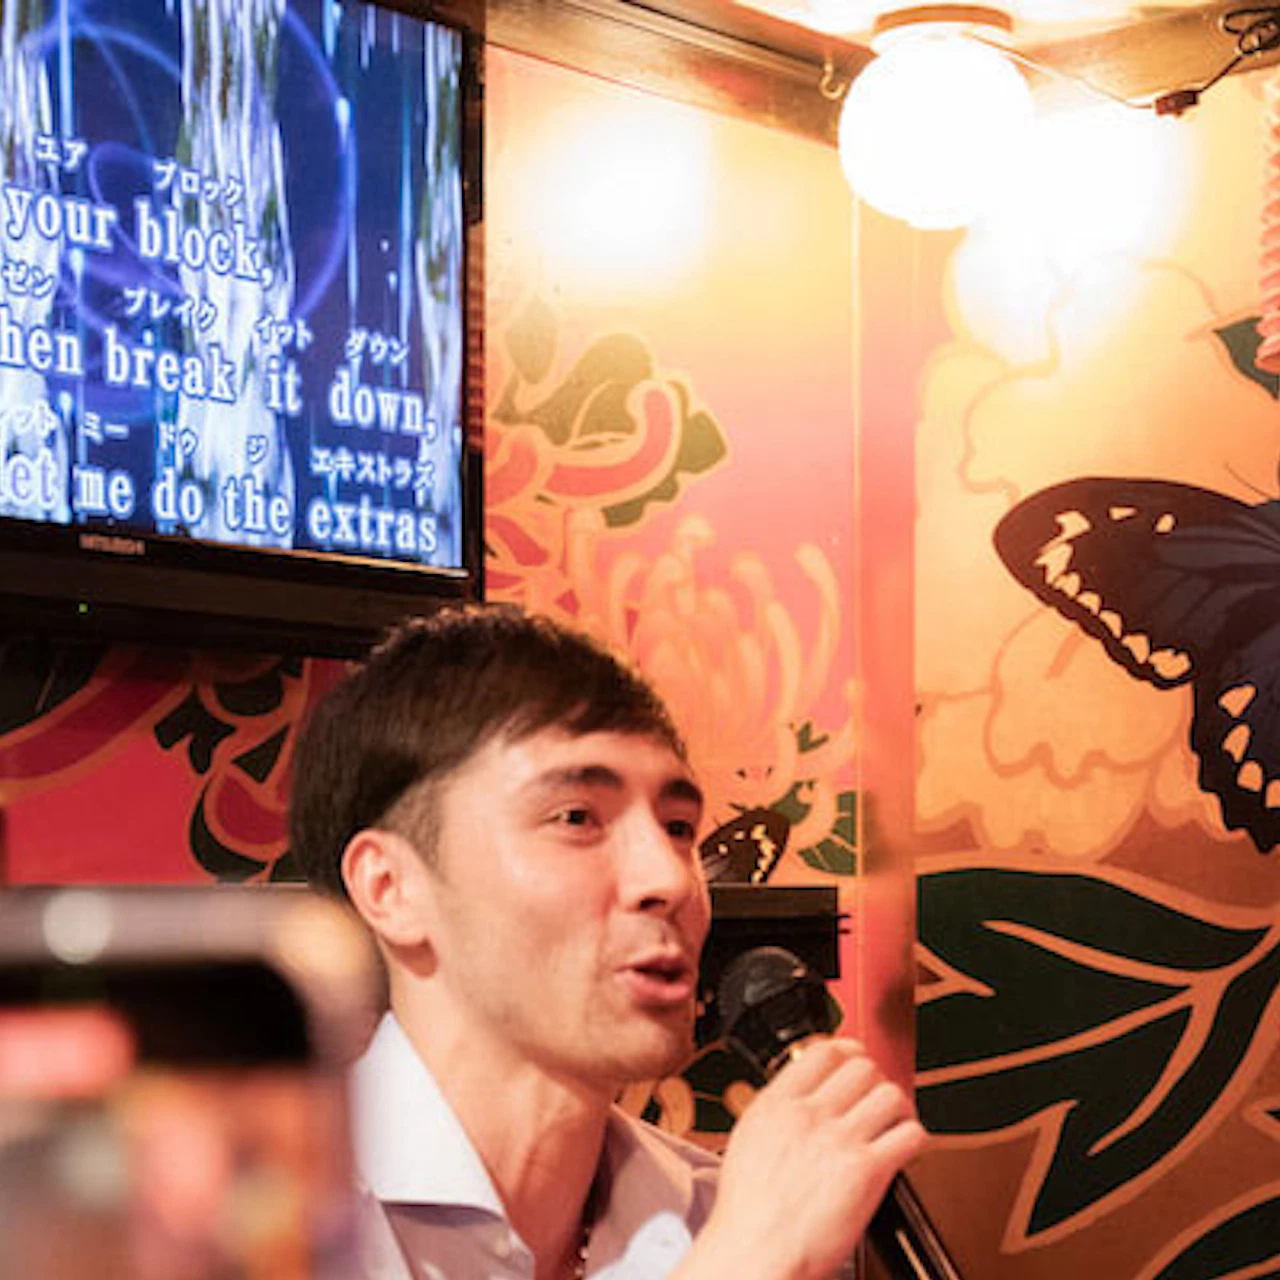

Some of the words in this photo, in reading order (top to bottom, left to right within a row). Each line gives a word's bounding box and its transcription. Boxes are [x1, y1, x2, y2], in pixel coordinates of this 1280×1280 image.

[36, 134, 88, 170] ユア
[5, 187, 117, 248] your
[136, 195, 274, 288] block,
[3, 260, 55, 297] ゼン
[256, 315, 312, 350] イット
[345, 327, 410, 366] ダウン
[83, 411, 130, 444] ミー
[104, 324, 235, 402] break
[267, 356, 302, 416] it
[329, 367, 437, 442] down,
[73, 466, 135, 518] me
[152, 466, 206, 524] do
[223, 474, 291, 534] the
[308, 494, 437, 552] extras
